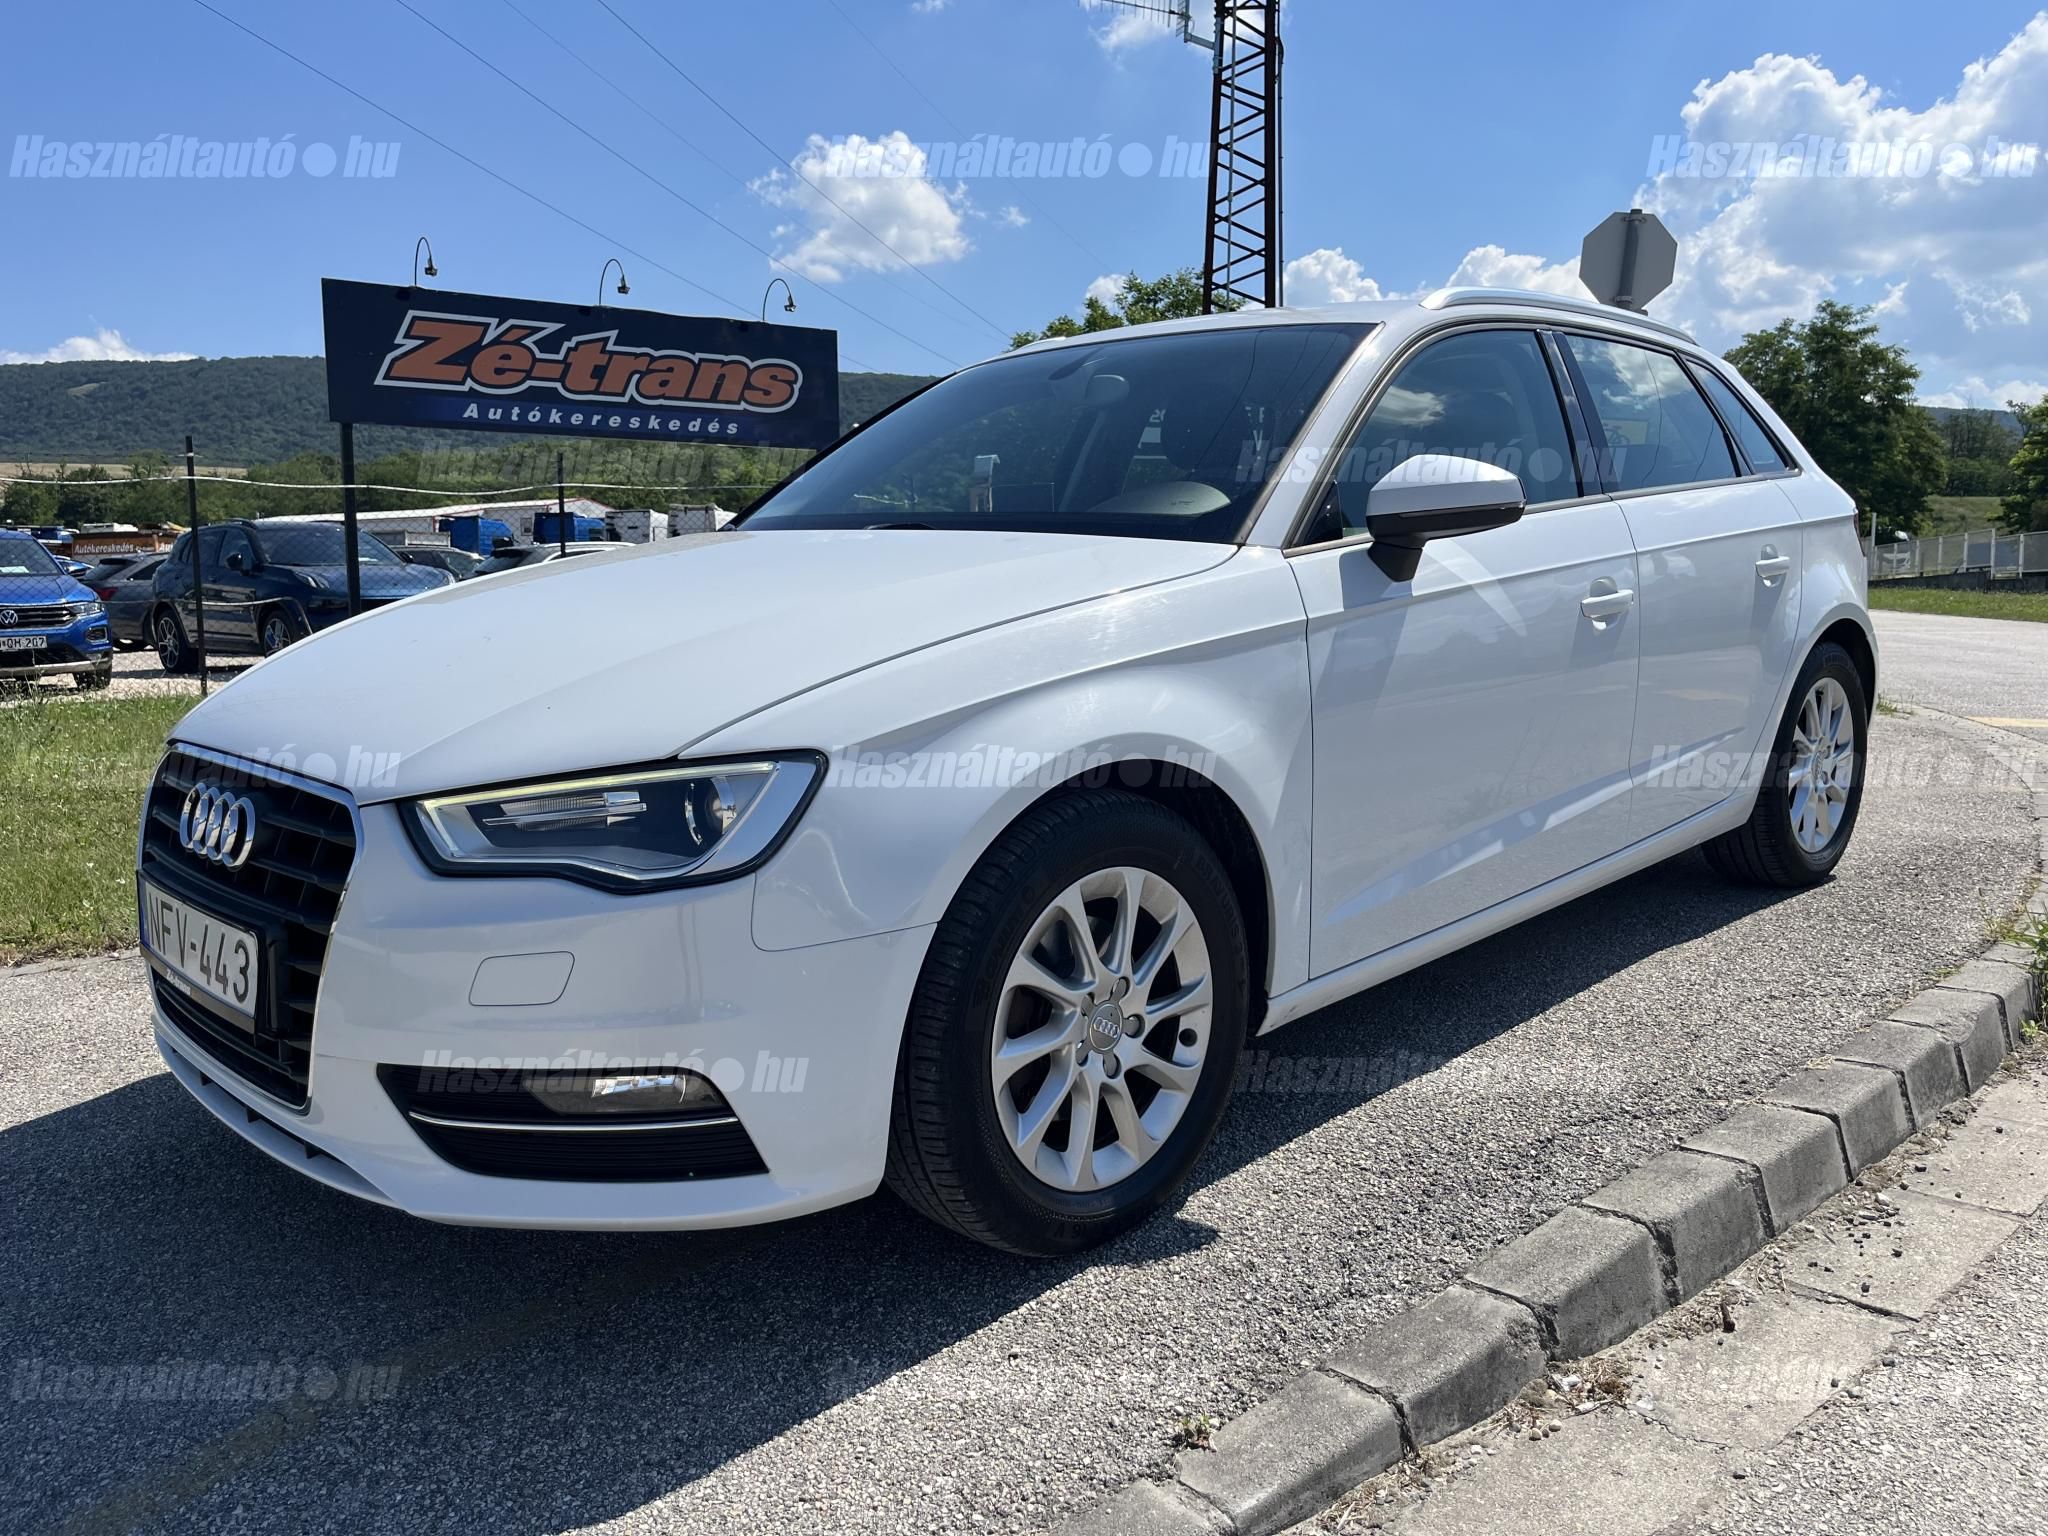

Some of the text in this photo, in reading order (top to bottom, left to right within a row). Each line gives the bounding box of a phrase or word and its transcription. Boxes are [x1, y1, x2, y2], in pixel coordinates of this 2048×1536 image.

[375, 309, 803, 412] Zé-trans
[463, 402, 739, 435] Autókereskedés
[148, 892, 250, 1003] NFV-443
